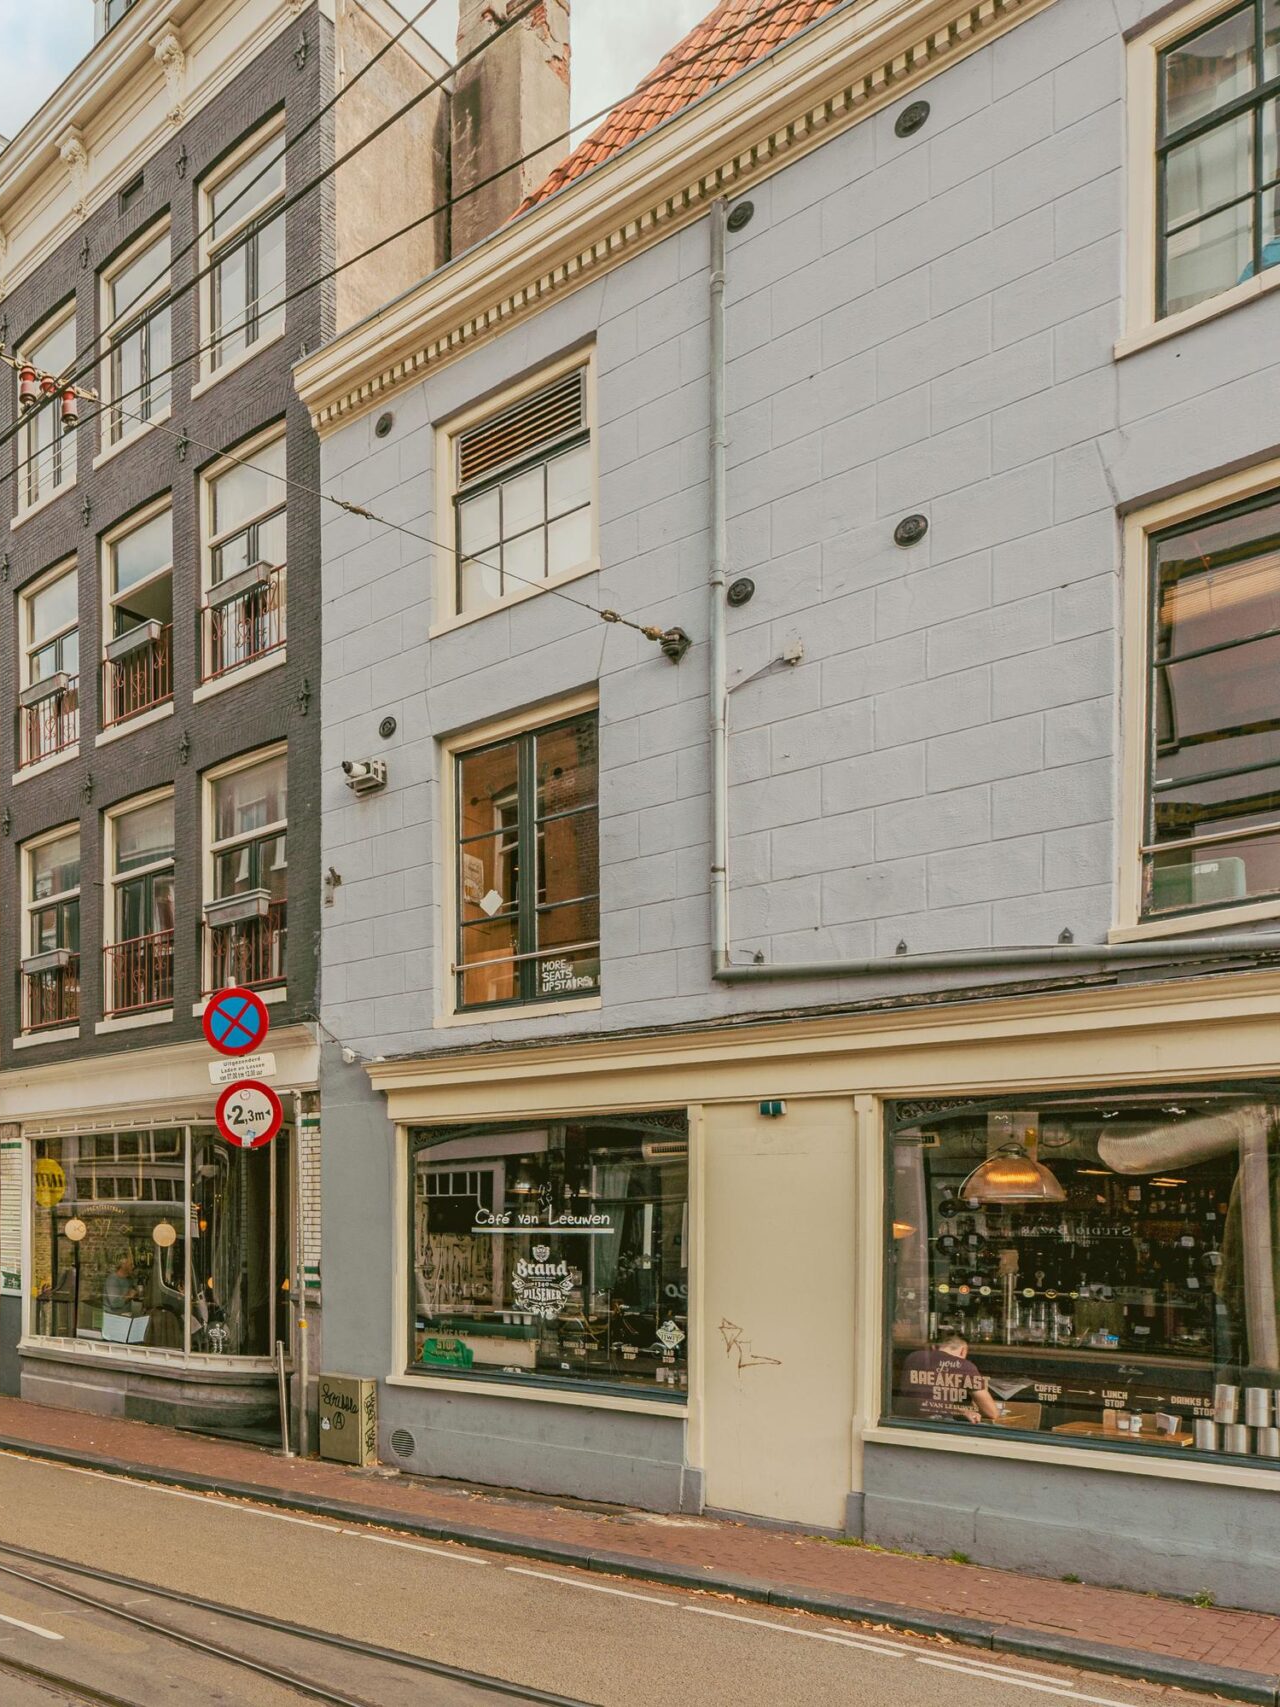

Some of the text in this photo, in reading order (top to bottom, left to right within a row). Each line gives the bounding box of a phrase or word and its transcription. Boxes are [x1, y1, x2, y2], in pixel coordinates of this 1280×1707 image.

[542, 959, 567, 972] MORE
[542, 969, 573, 982] SEATS
[543, 975, 593, 992] UPSTAIRS
[220, 1066, 238, 1074] Laden
[246, 1062, 265, 1070] Lossen
[223, 1056, 261, 1067] Uitgezonderd
[231, 1104, 265, 1126] 2,3m
[474, 1204, 611, 1226] Café van Leeuwen
[517, 1258, 568, 1278] Brand
[523, 1287, 562, 1302] PILSENER
[935, 1360, 961, 1373] your
[909, 1369, 991, 1392] BREAKFAST
[932, 1385, 968, 1403] STOP
[1034, 1383, 1062, 1394] COFFEE
[1101, 1389, 1128, 1400] LUNCH
[1038, 1393, 1058, 1402] STOP
[1104, 1399, 1125, 1408] STOP
[1170, 1395, 1202, 1406] DRINKS
[1203, 1398, 1212, 1407] &
[1192, 1406, 1216, 1417] STOP
